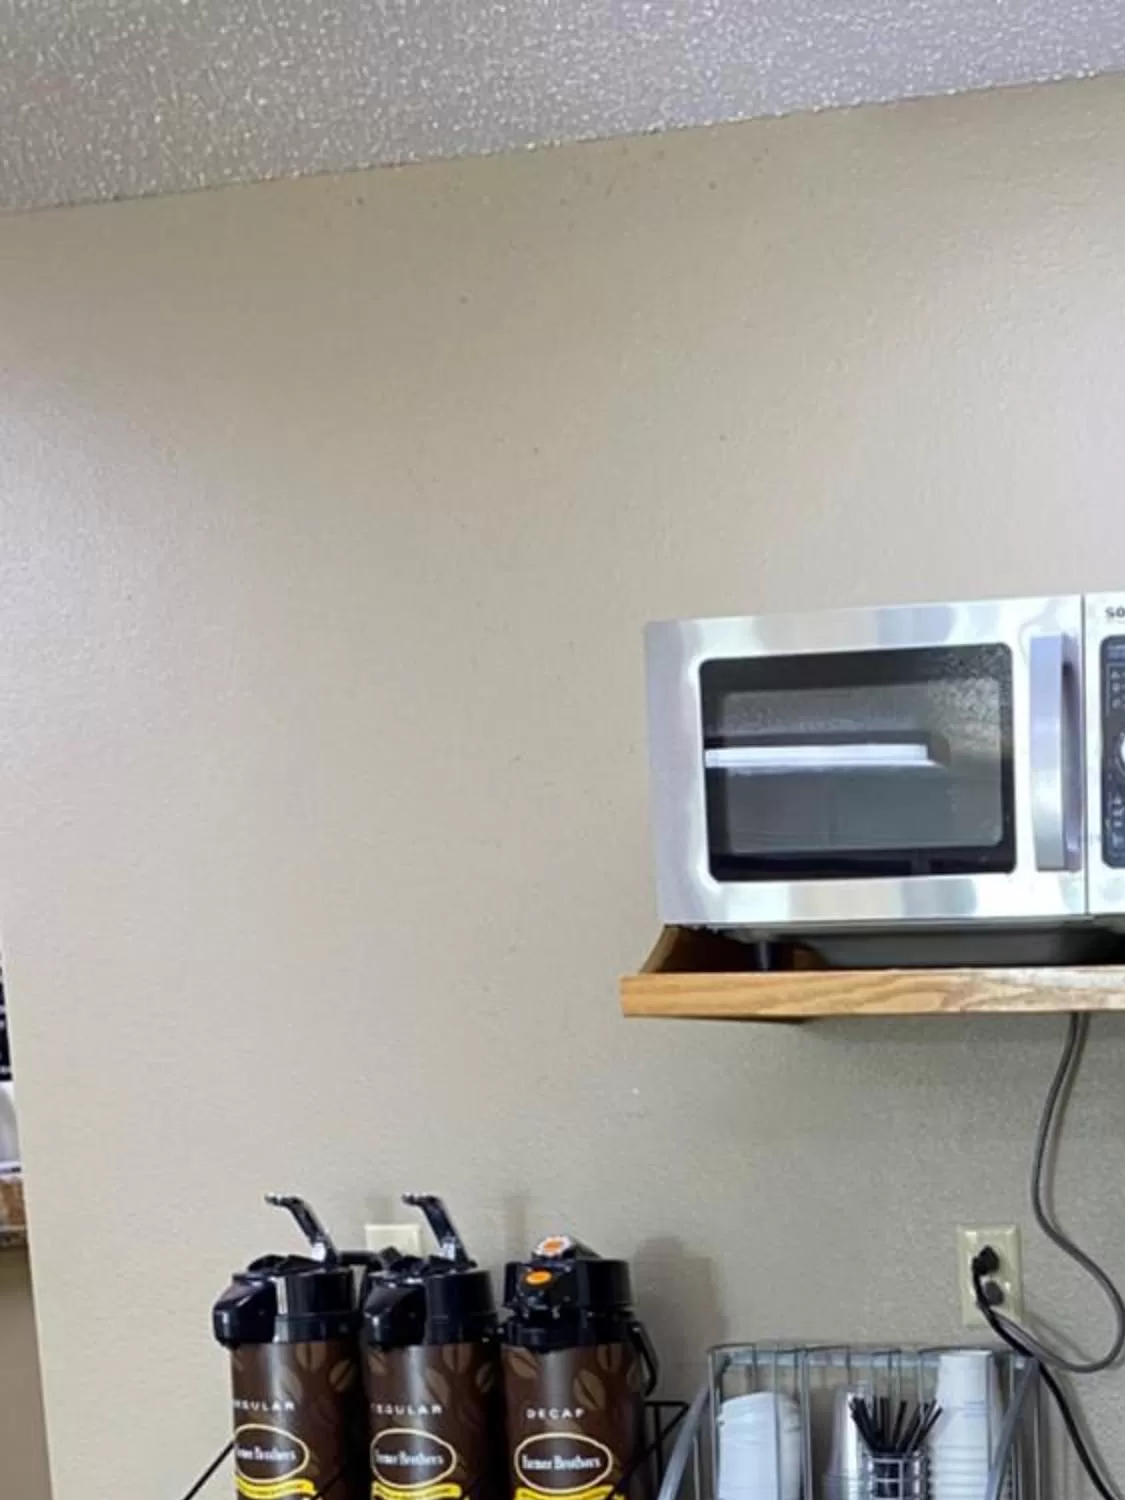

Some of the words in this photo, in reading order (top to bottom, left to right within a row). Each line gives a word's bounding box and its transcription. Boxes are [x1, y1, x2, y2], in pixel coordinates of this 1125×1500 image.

[233, 1400, 296, 1412] EGULAR
[371, 1403, 443, 1416] EGULAR
[526, 1408, 585, 1419] DECAF
